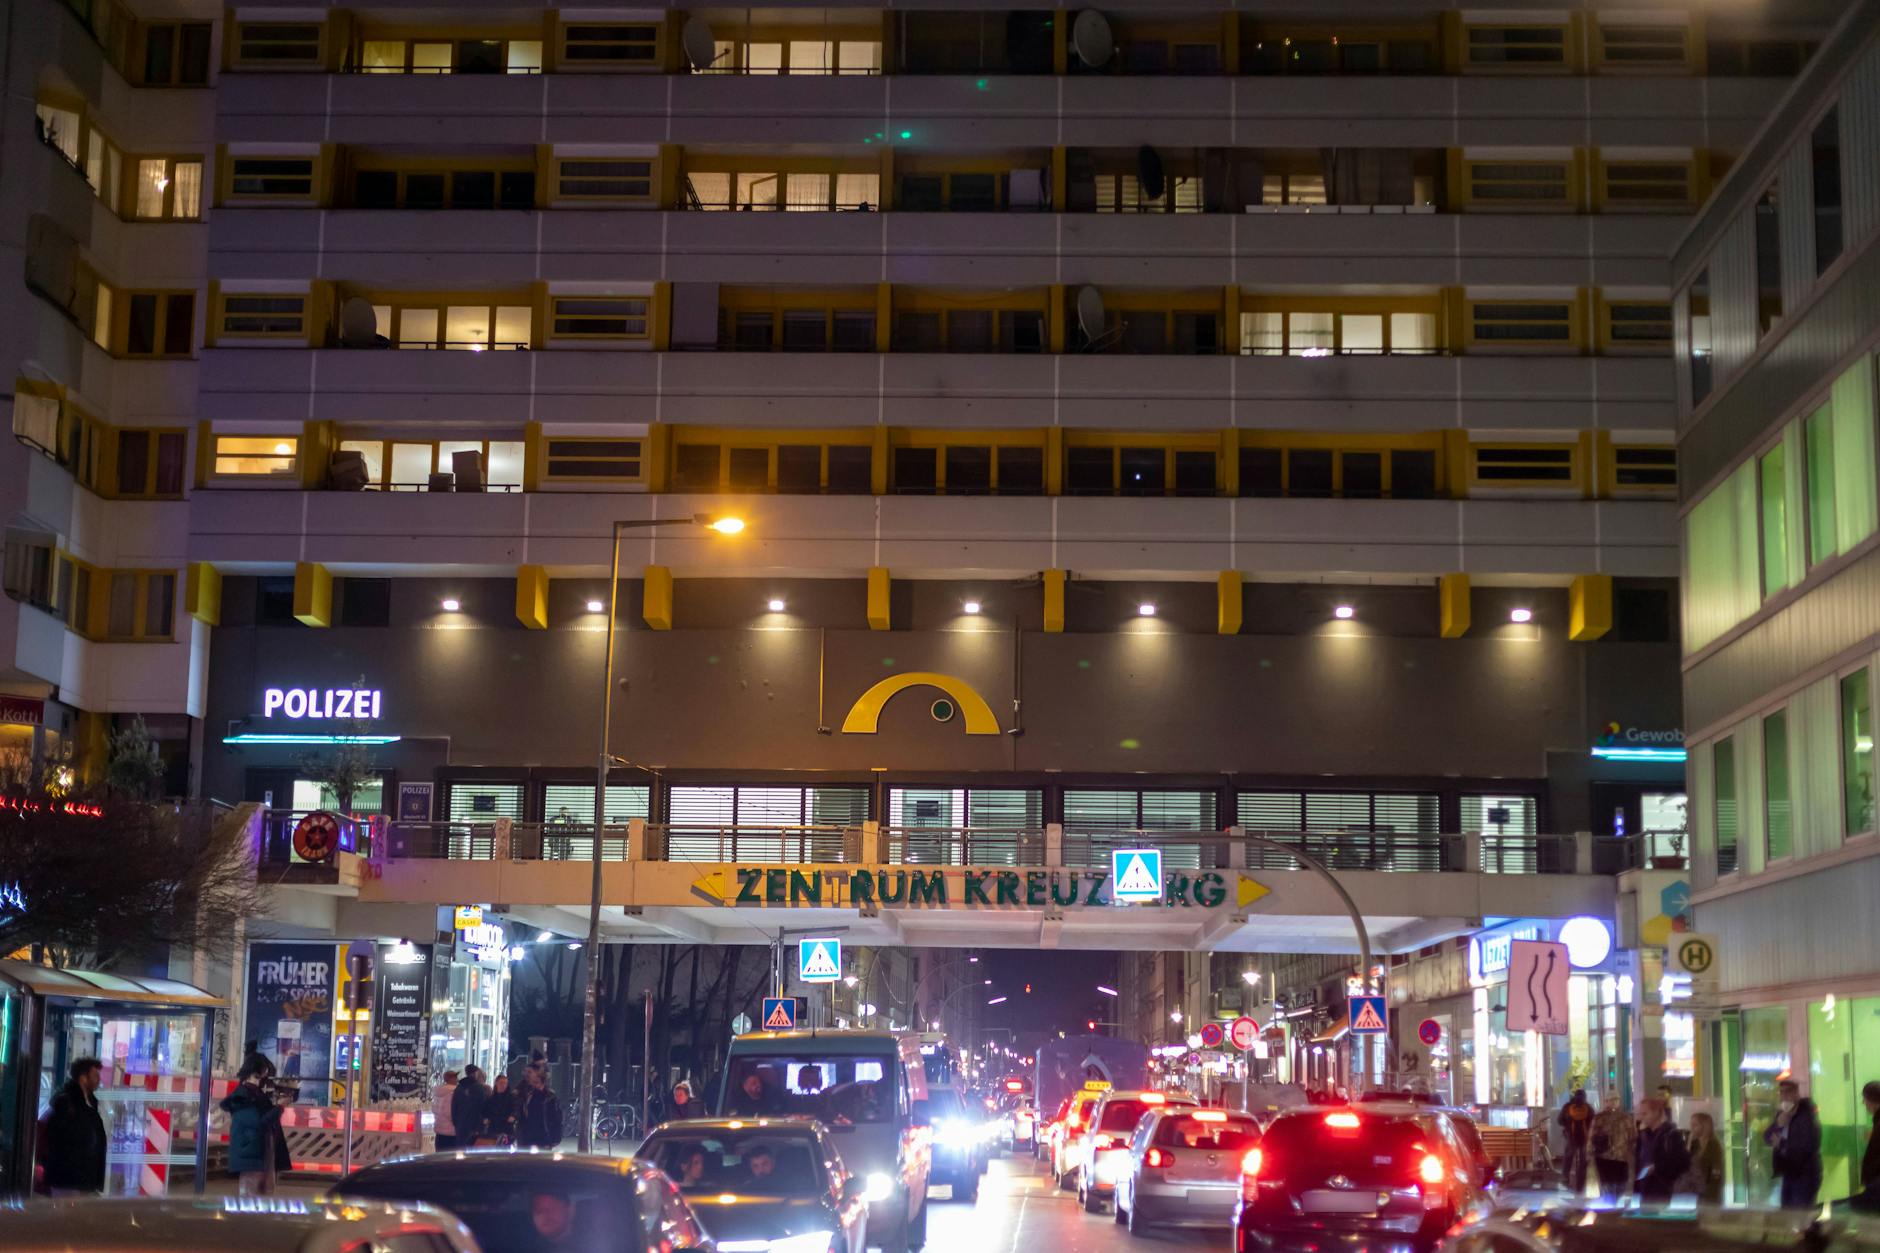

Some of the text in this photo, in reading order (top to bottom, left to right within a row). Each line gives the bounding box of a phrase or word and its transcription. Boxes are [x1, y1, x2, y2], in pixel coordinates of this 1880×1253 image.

[264, 688, 381, 719] POLIZEI
[402, 787, 430, 795] POLIZEI
[735, 868, 1227, 908] ZENTRUM KREUZRG
[257, 956, 329, 985] FRÜHER
[390, 982, 419, 991] Tabakwaren
[392, 996, 416, 1004] Getränke
